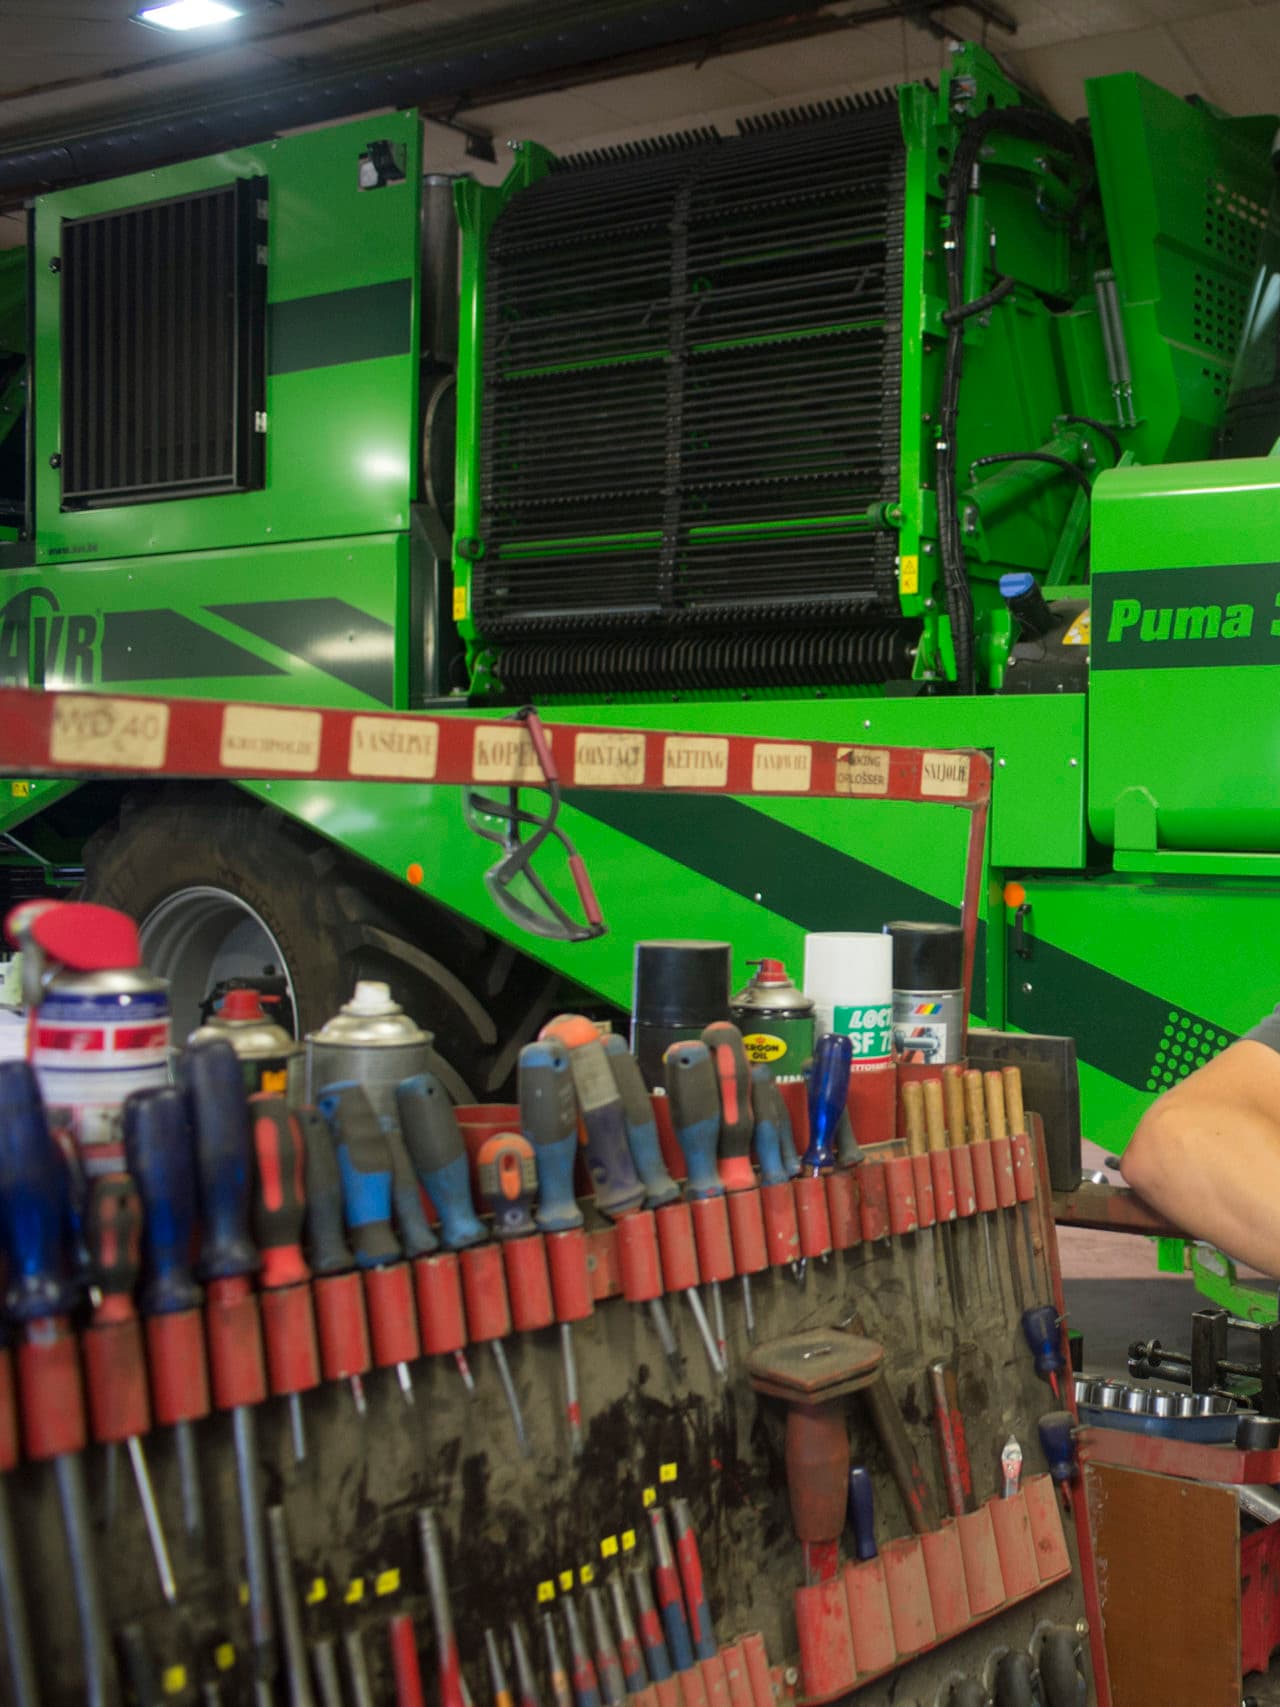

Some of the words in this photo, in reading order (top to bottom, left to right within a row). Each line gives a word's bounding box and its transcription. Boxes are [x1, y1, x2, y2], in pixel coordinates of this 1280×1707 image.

[1107, 598, 1255, 643] Puma
[577, 743, 641, 767] CONTACT
[667, 749, 724, 770] KETTING
[848, 1031, 875, 1055] SF
